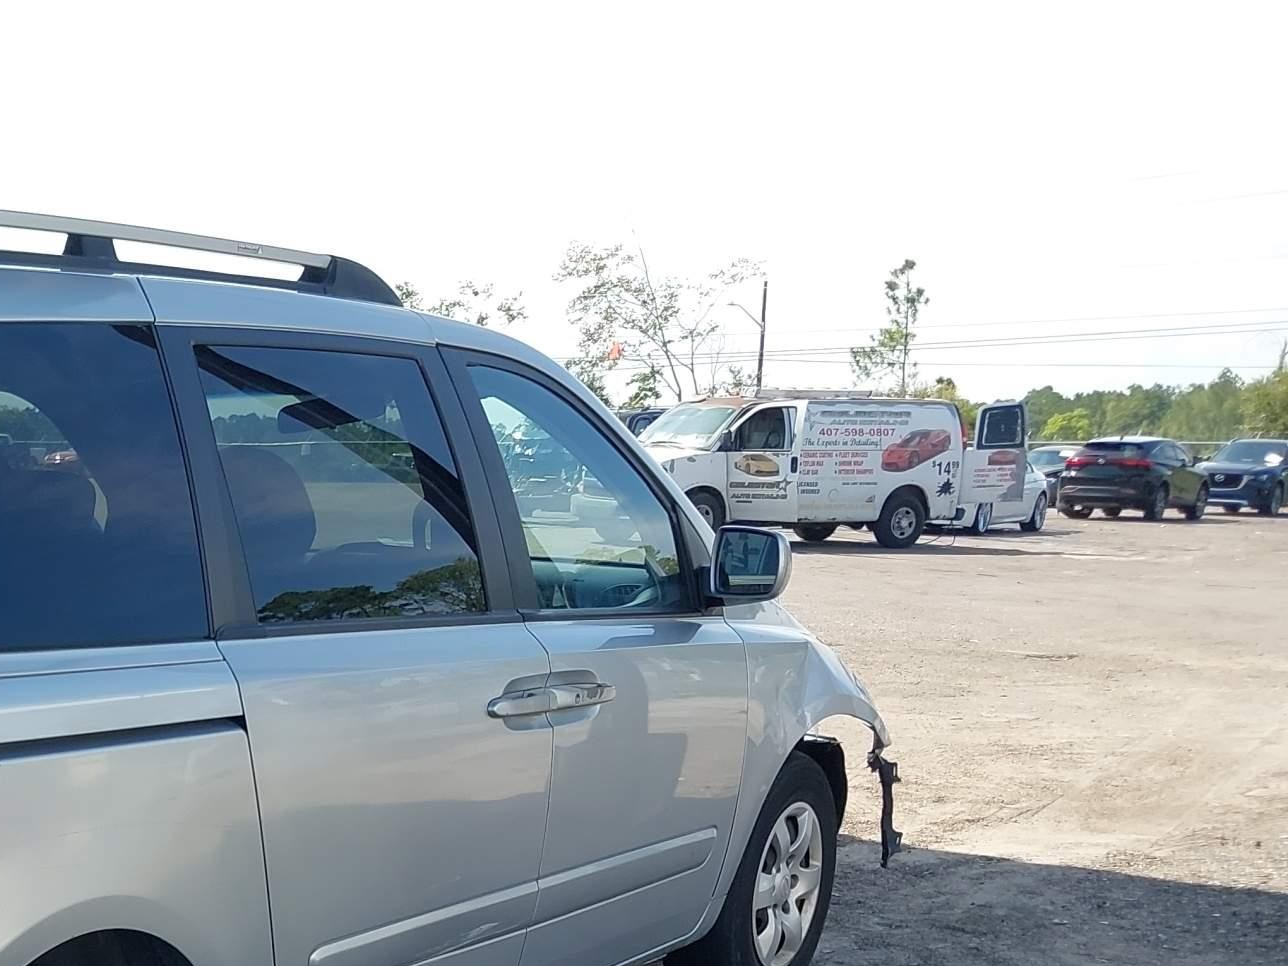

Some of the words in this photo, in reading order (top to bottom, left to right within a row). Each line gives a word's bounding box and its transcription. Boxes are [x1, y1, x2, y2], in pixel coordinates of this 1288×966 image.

[819, 428, 896, 437] 407-598-0807
[803, 438, 815, 446] The
[817, 438, 840, 448] Experts
